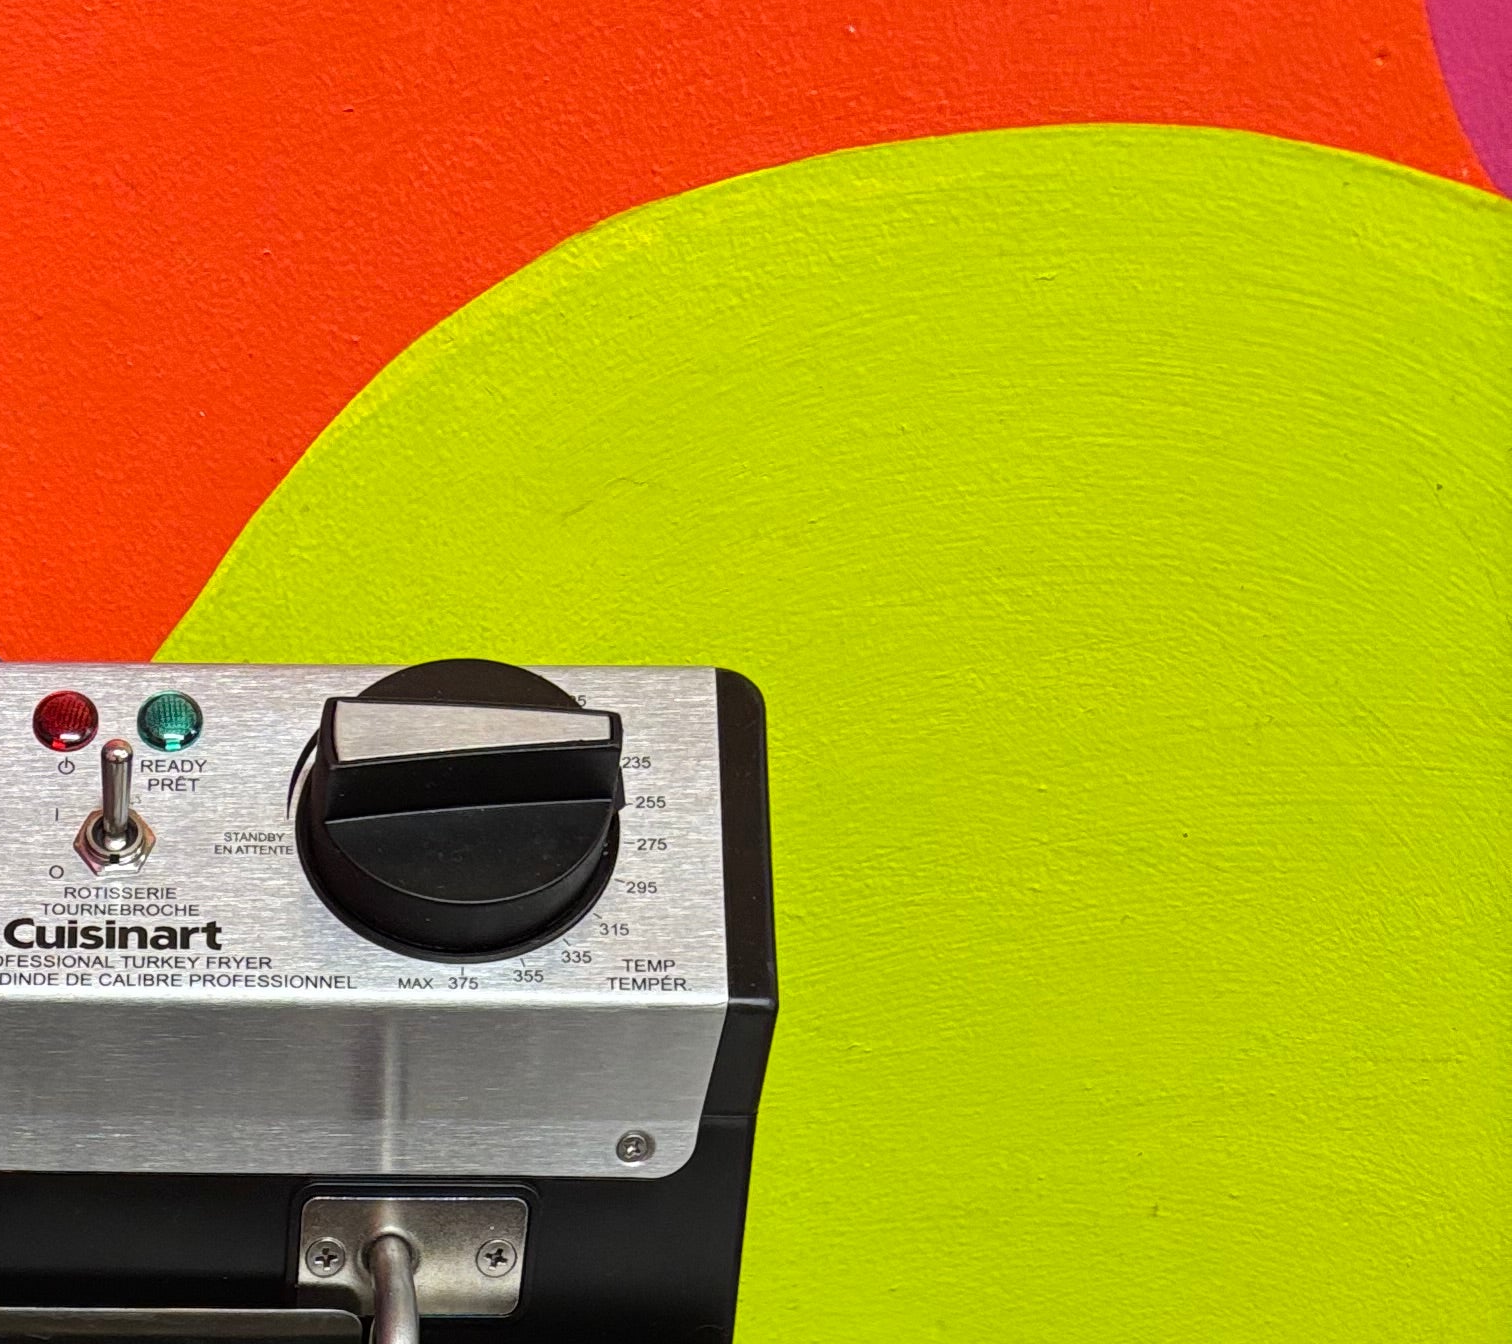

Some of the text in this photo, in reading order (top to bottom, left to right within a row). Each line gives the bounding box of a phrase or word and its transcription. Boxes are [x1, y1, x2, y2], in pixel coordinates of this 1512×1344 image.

[140, 759, 207, 773] READY
[622, 756, 651, 769] 235
[147, 776, 200, 792] PRÊT
[637, 796, 666, 809] 255
[223, 832, 284, 843] STANDBY
[637, 838, 667, 851] 275
[214, 845, 294, 856] EN ATTENTE
[64, 887, 177, 900] ROTISSERIE
[626, 881, 658, 895] 295
[42, 903, 200, 917] TOURNEBROCHE
[4, 917, 223, 951] Cuisinart
[600, 923, 630, 937] 315
[120, 955, 200, 970] TURKEY
[206, 956, 273, 970] FRYER
[561, 951, 593, 965] 335
[624, 960, 676, 973] TEMP
[65, 973, 92, 986] DE
[98, 973, 183, 987] CALIBRE
[188, 974, 358, 990] PROFESSIONNEL
[398, 976, 479, 990] MAX 375
[513, 969, 544, 984] 355
[607, 973, 693, 991] TEMPÉR.
